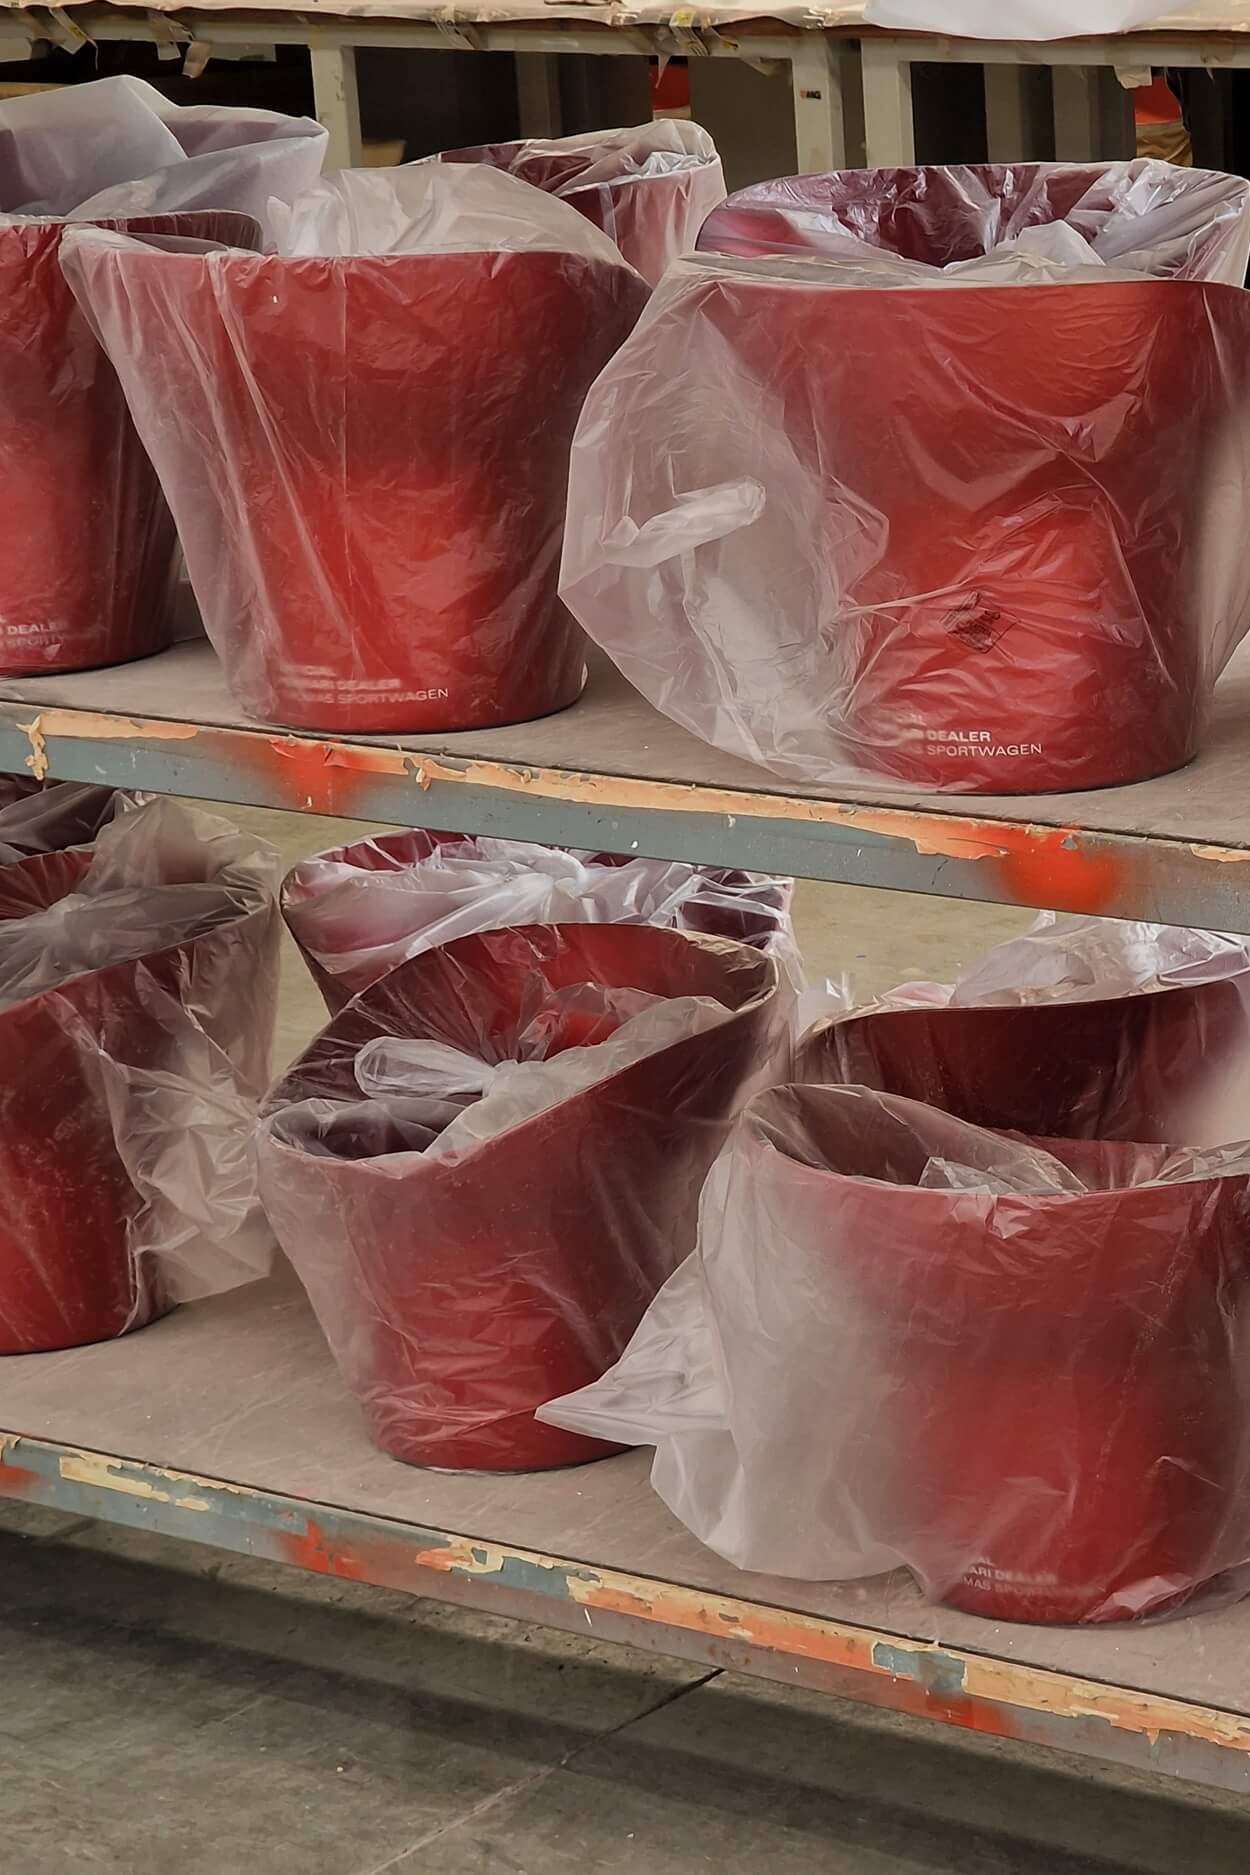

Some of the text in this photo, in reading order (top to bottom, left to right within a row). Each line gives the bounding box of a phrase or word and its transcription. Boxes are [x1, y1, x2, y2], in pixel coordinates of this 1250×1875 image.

[7, 621, 63, 636] DEALE
[337, 688, 449, 704] SPORTWAGEN
[926, 730, 991, 743] DEALER
[927, 743, 1042, 757] SPORTWAGEN
[962, 1574, 992, 1592] MAS
